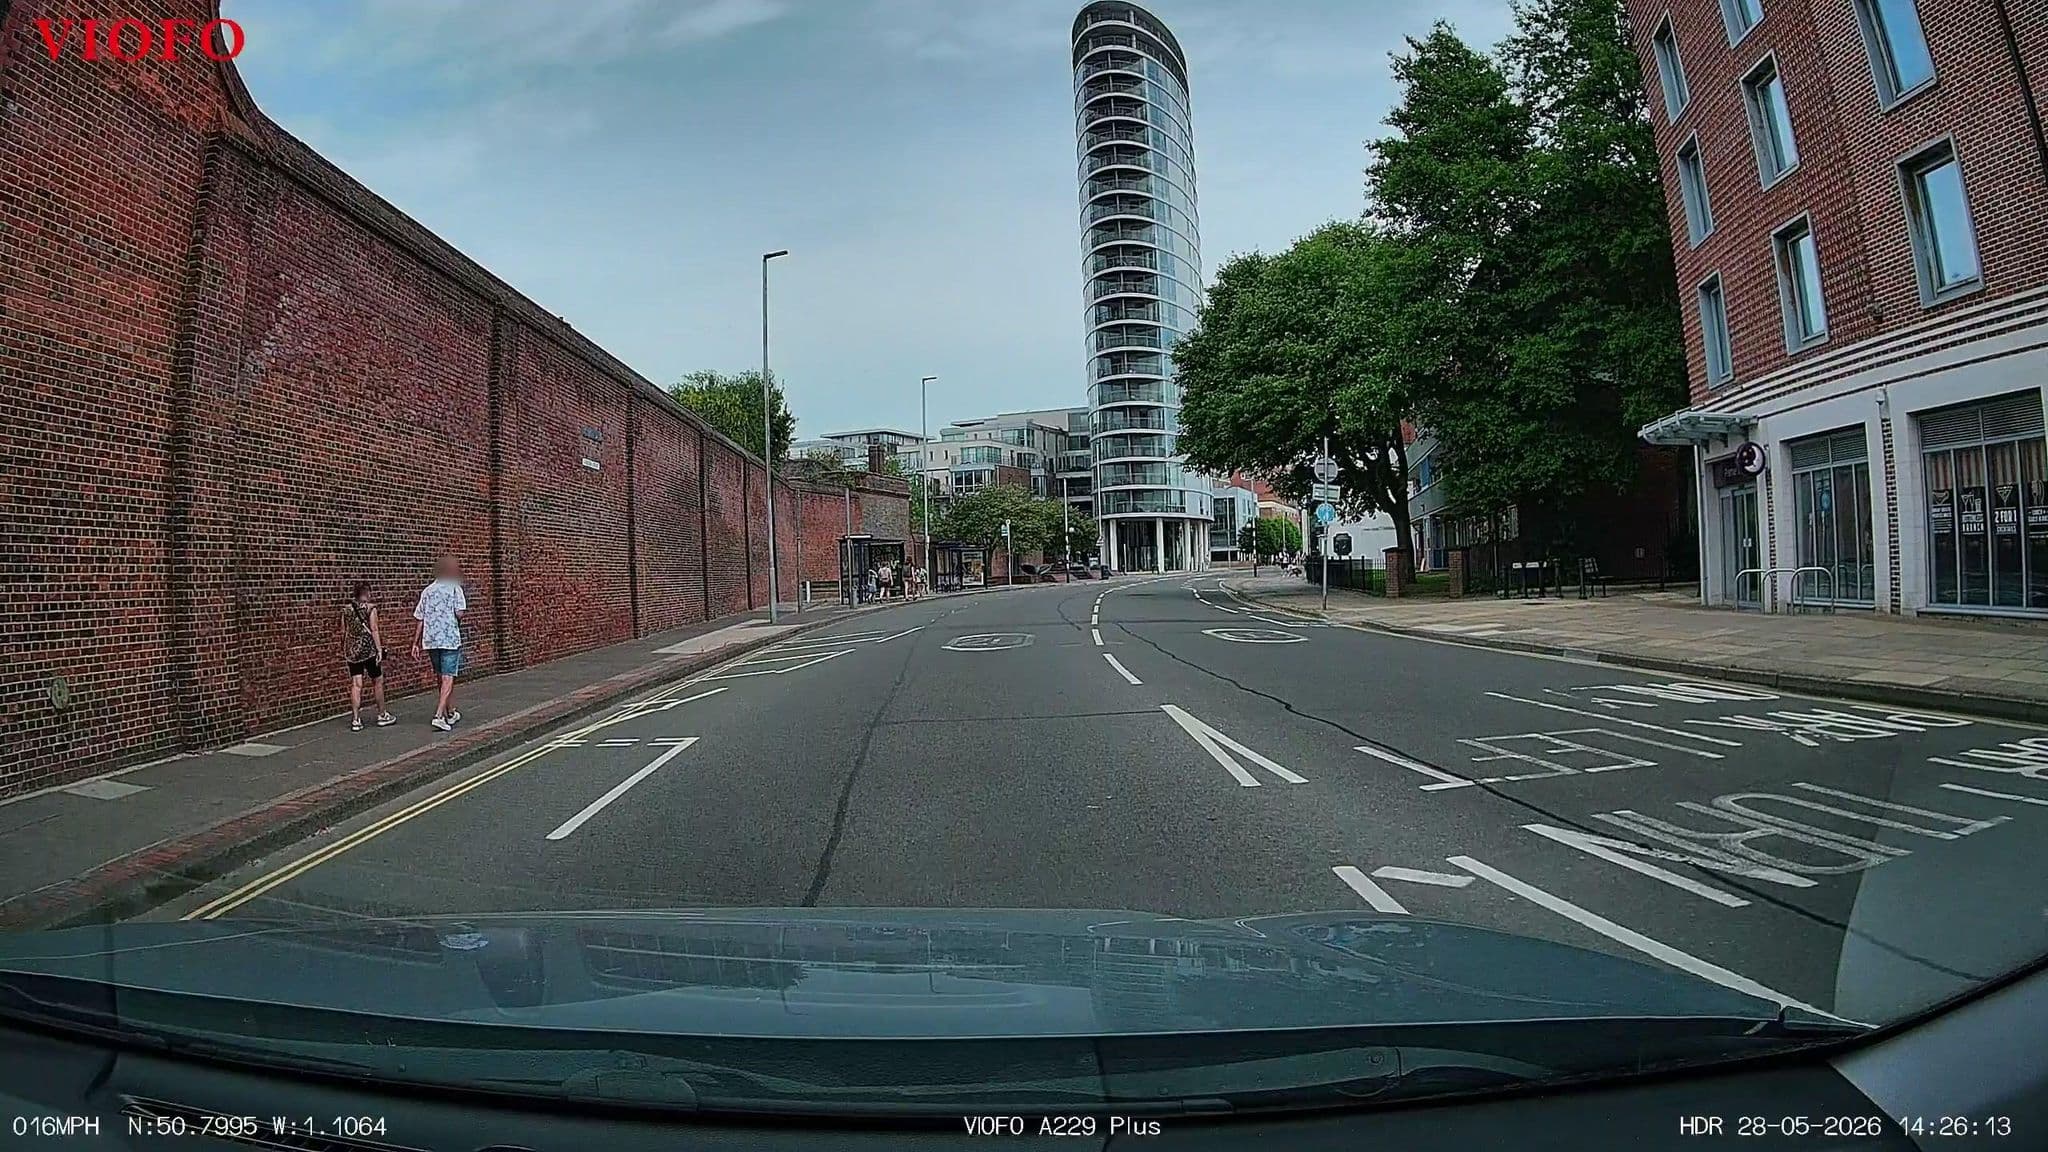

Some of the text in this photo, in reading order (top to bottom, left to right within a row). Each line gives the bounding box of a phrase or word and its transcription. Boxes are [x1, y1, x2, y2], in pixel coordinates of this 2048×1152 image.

[1994, 510, 1999, 523] 2
[1683, 705, 1975, 747] PARK
[1353, 728, 1725, 791] LEFT
[1521, 782, 2013, 907] TURN
